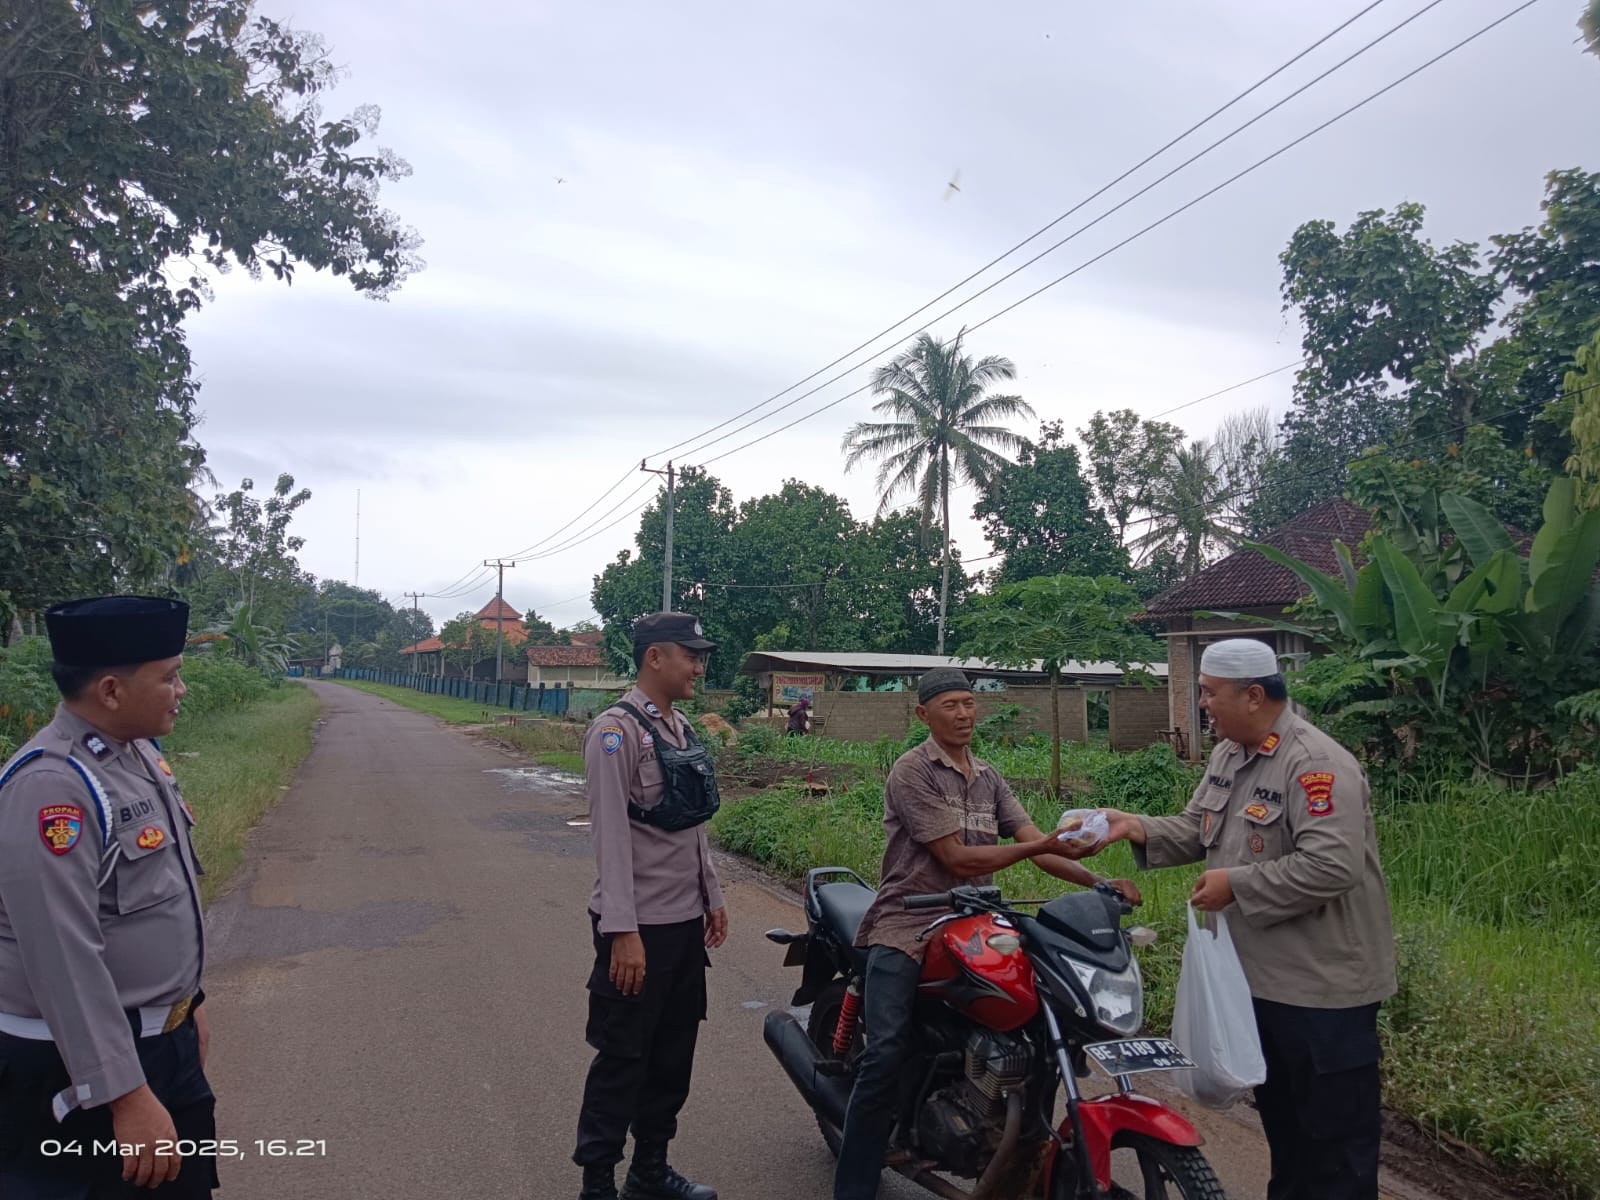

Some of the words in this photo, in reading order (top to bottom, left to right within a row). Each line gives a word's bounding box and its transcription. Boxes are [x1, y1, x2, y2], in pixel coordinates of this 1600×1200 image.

[1253, 786, 1282, 804] POLRI
[42, 807, 81, 816] PROPAM
[120, 798, 155, 822] BUDI
[1089, 1045, 1117, 1060] BE
[1118, 1040, 1156, 1057] 4189
